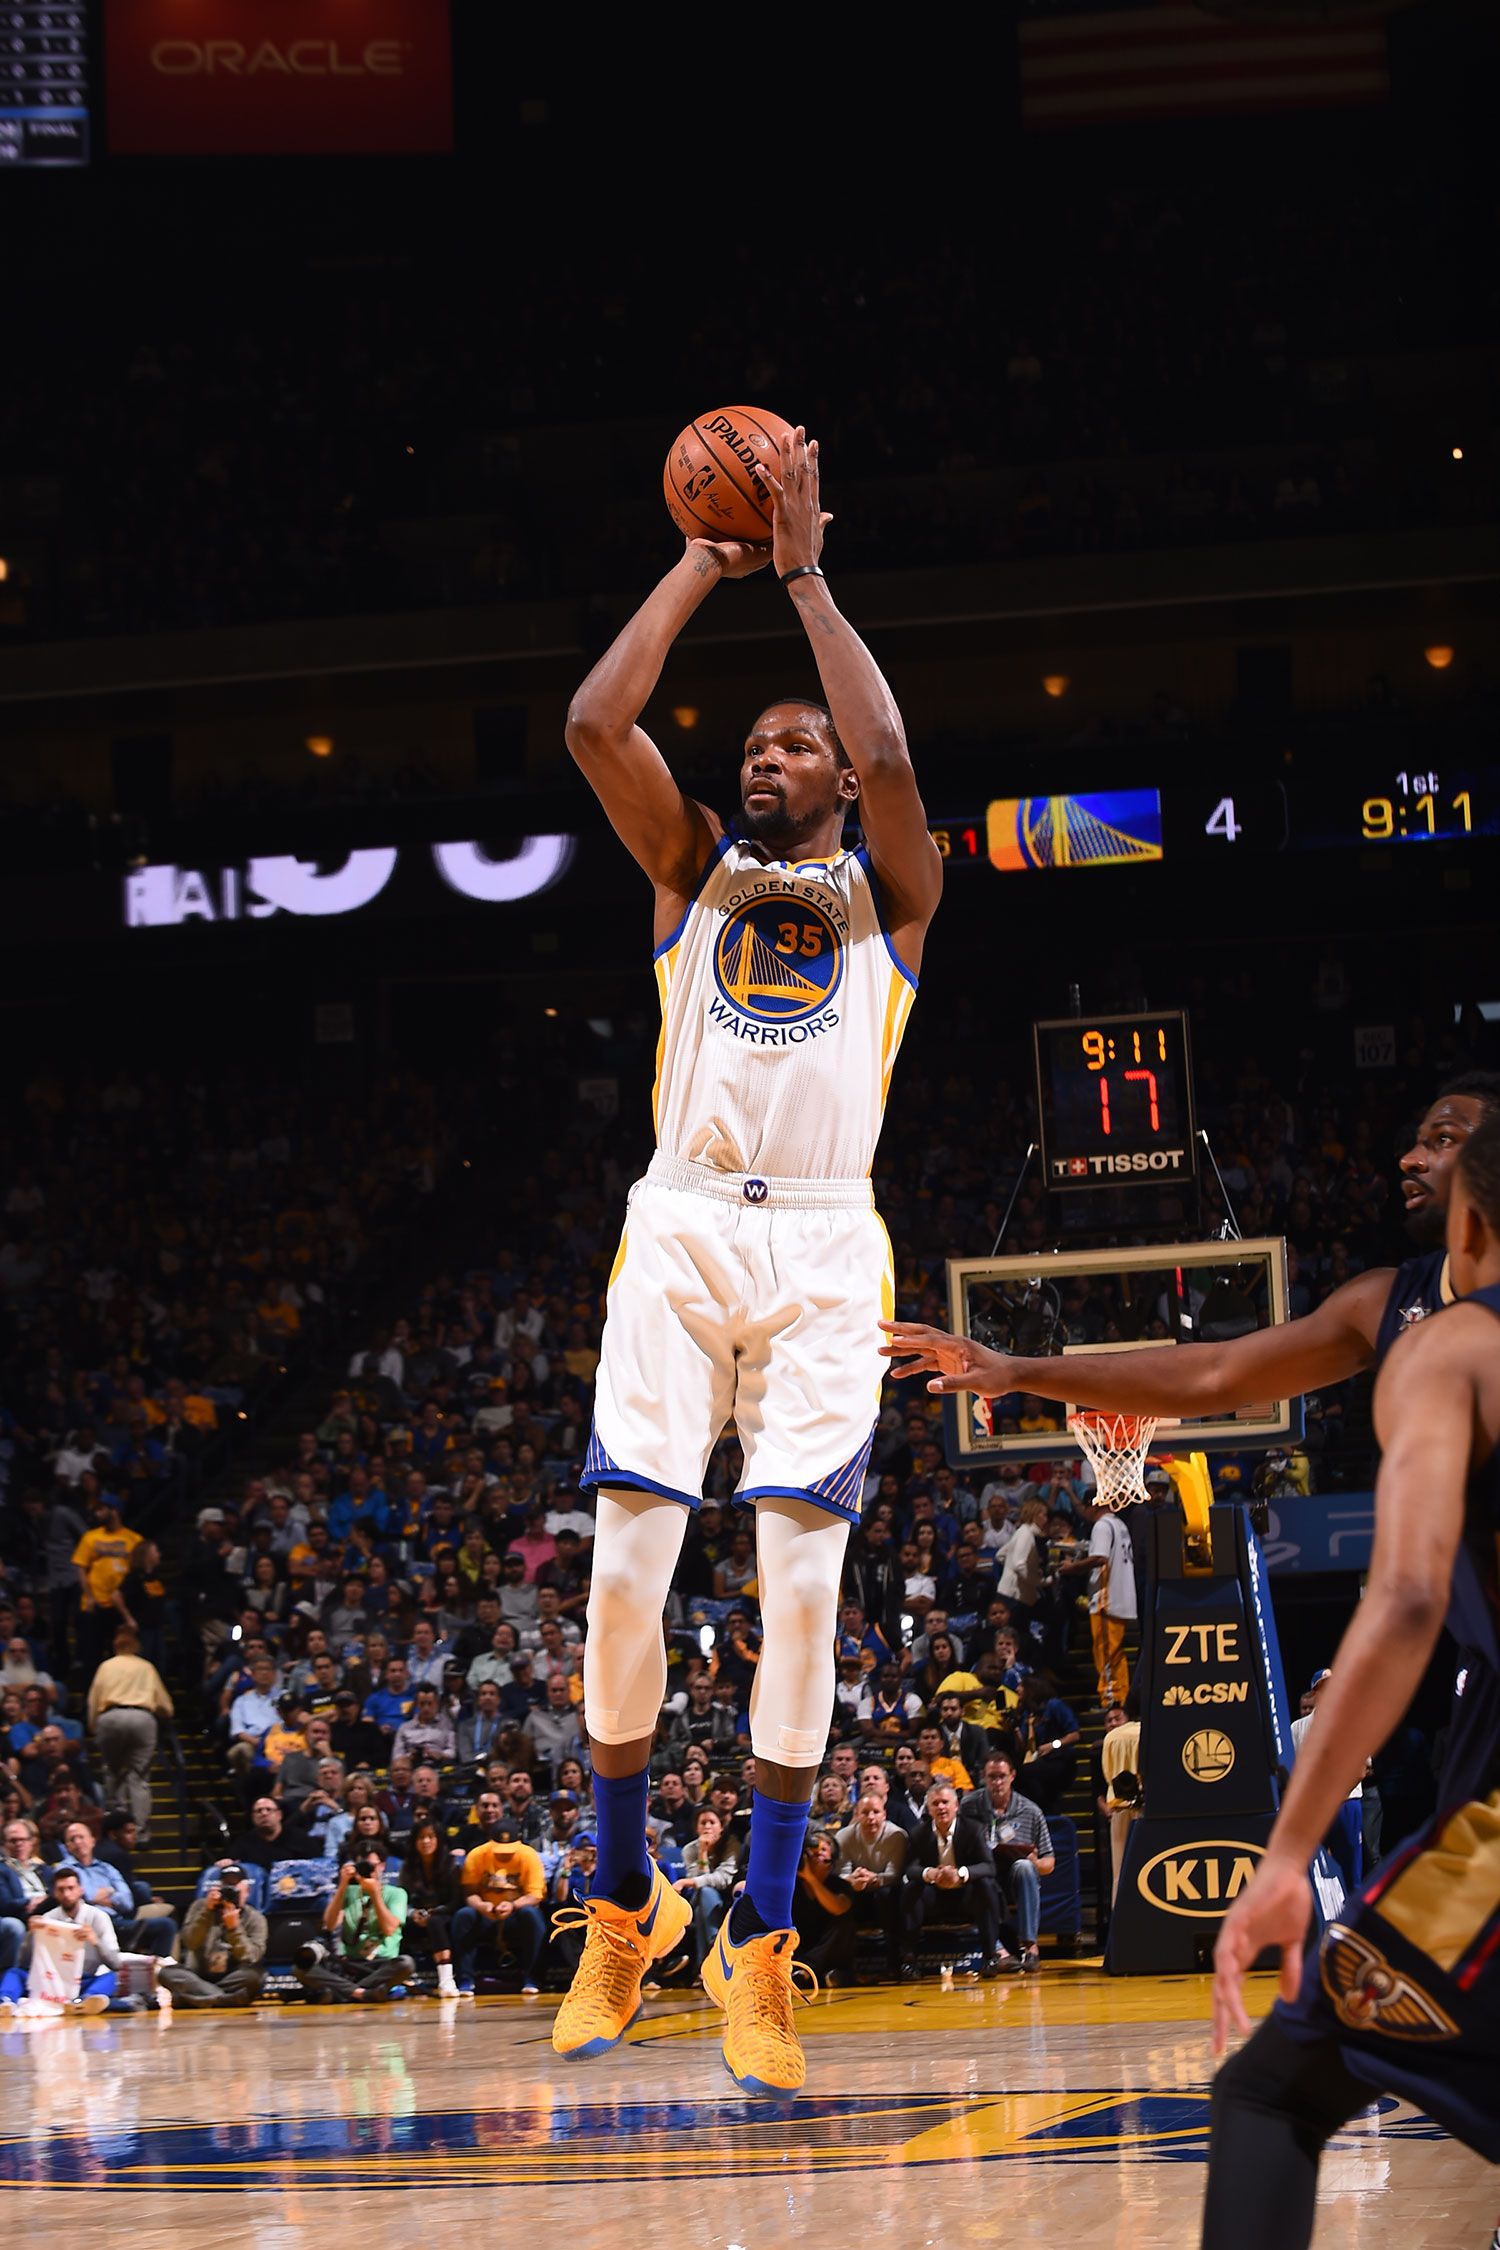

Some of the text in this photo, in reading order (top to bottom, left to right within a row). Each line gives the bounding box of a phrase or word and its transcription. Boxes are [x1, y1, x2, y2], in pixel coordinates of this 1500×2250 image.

[151, 39, 403, 75] ORACLE
[1396, 770, 1440, 796] 1st
[1205, 797, 1242, 842] 4
[1362, 790, 1472, 839] 9:11
[718, 881, 849, 934] GOLDEN STATE
[774, 922, 824, 958] 35
[708, 996, 840, 1046] WARRIORS
[1082, 1028, 1167, 1071] 9:11
[1100, 1069, 1160, 1135] 17
[1089, 1149, 1184, 1175] TISSOT
[746, 1183, 765, 1199] W
[1164, 1623, 1240, 1665] ZTE
[1193, 1681, 1249, 1705] CSN
